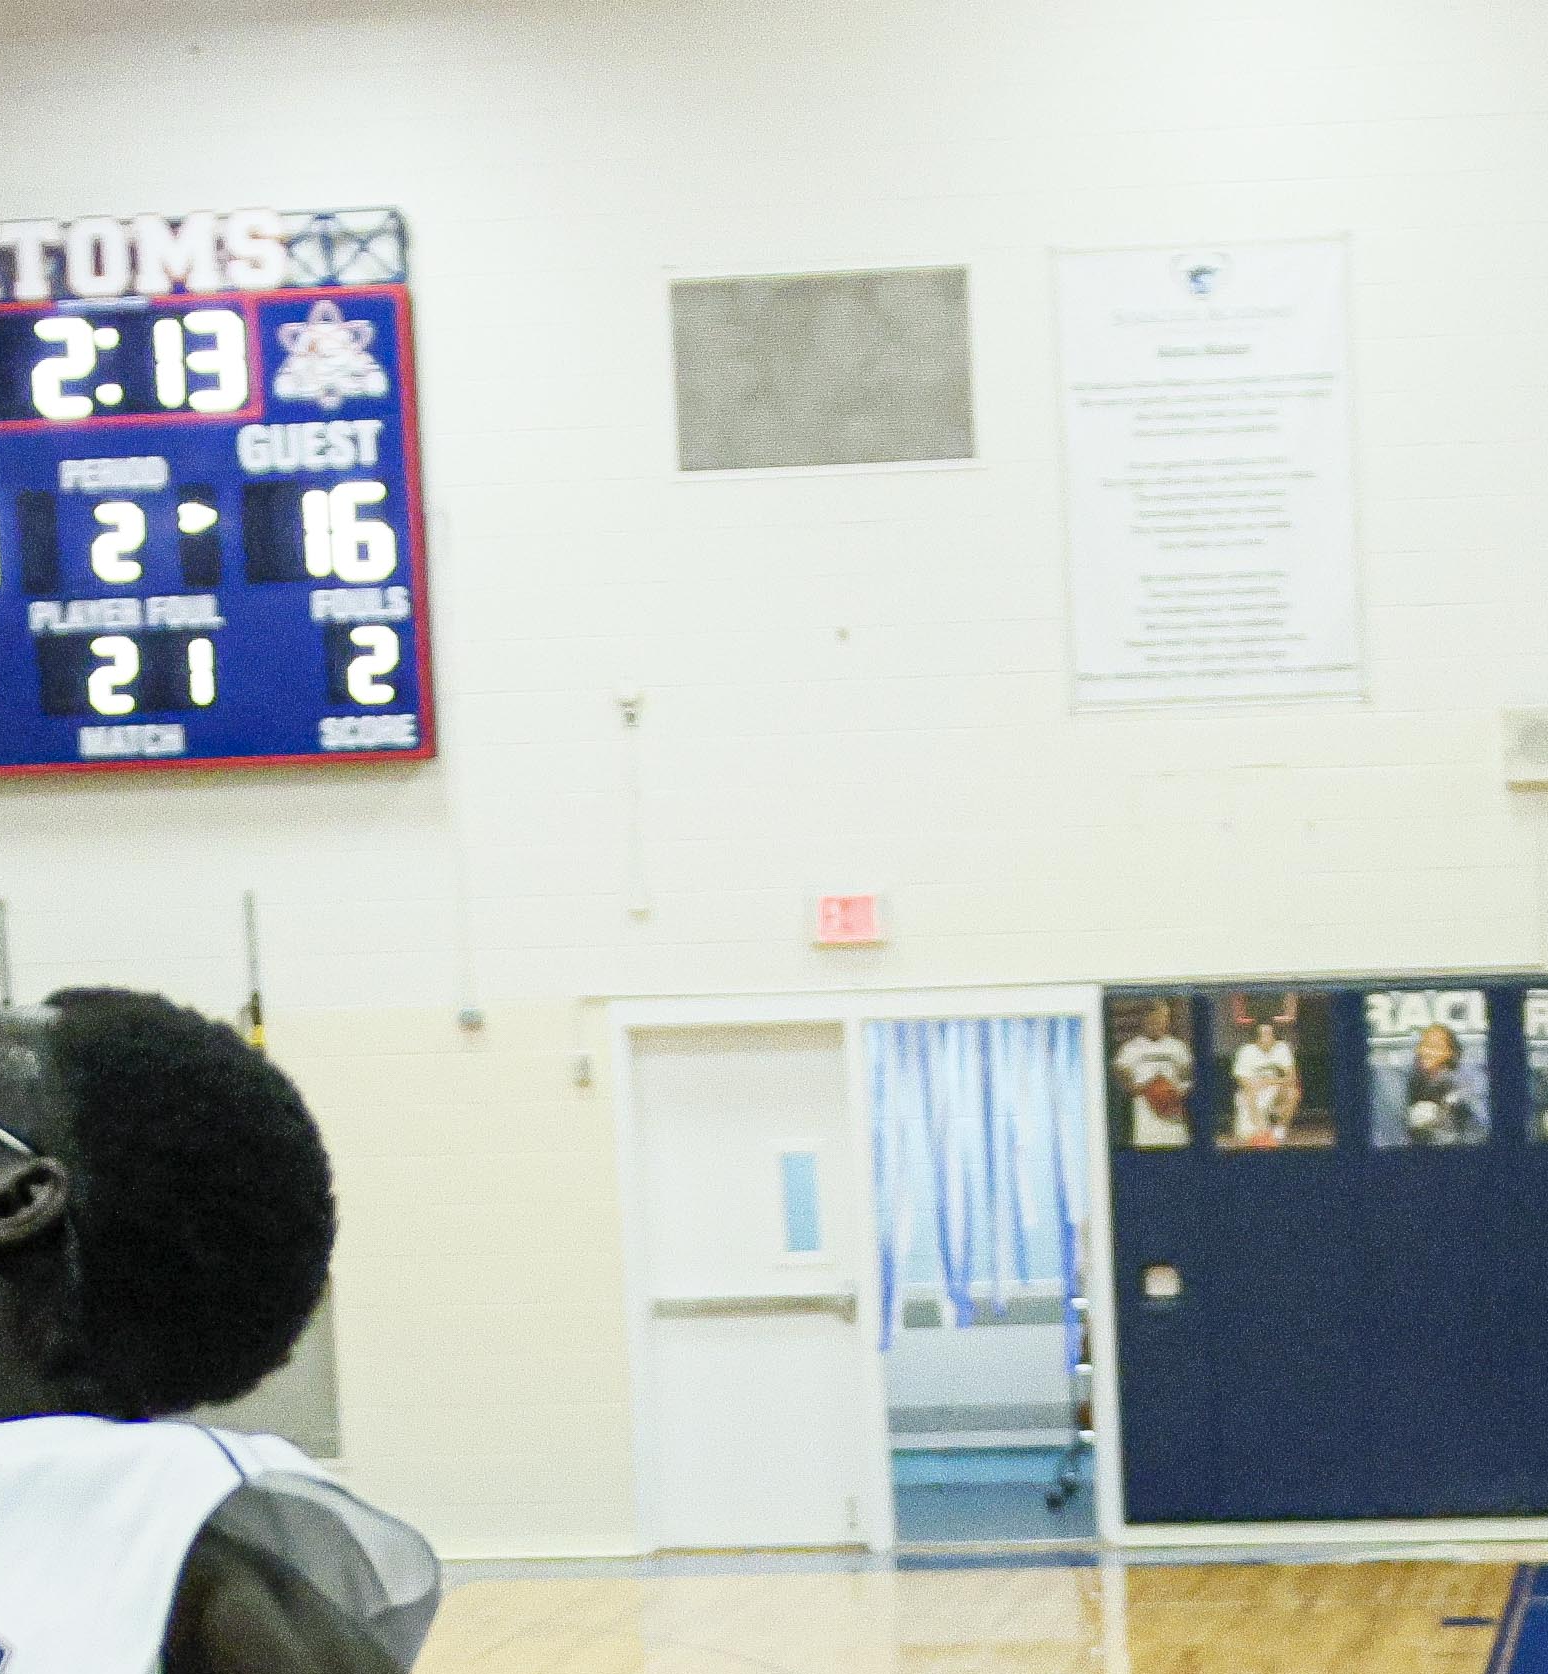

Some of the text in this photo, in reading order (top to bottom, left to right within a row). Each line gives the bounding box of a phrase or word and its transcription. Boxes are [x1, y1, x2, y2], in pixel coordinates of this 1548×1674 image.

[31, 308, 248, 421] 2:13
[237, 419, 384, 471] GUEST
[90, 501, 146, 584] 2
[301, 480, 397, 583] 16
[28, 593, 226, 636] PLAYER FOUL
[309, 586, 411, 624] FOULS
[347, 624, 401, 705] 2
